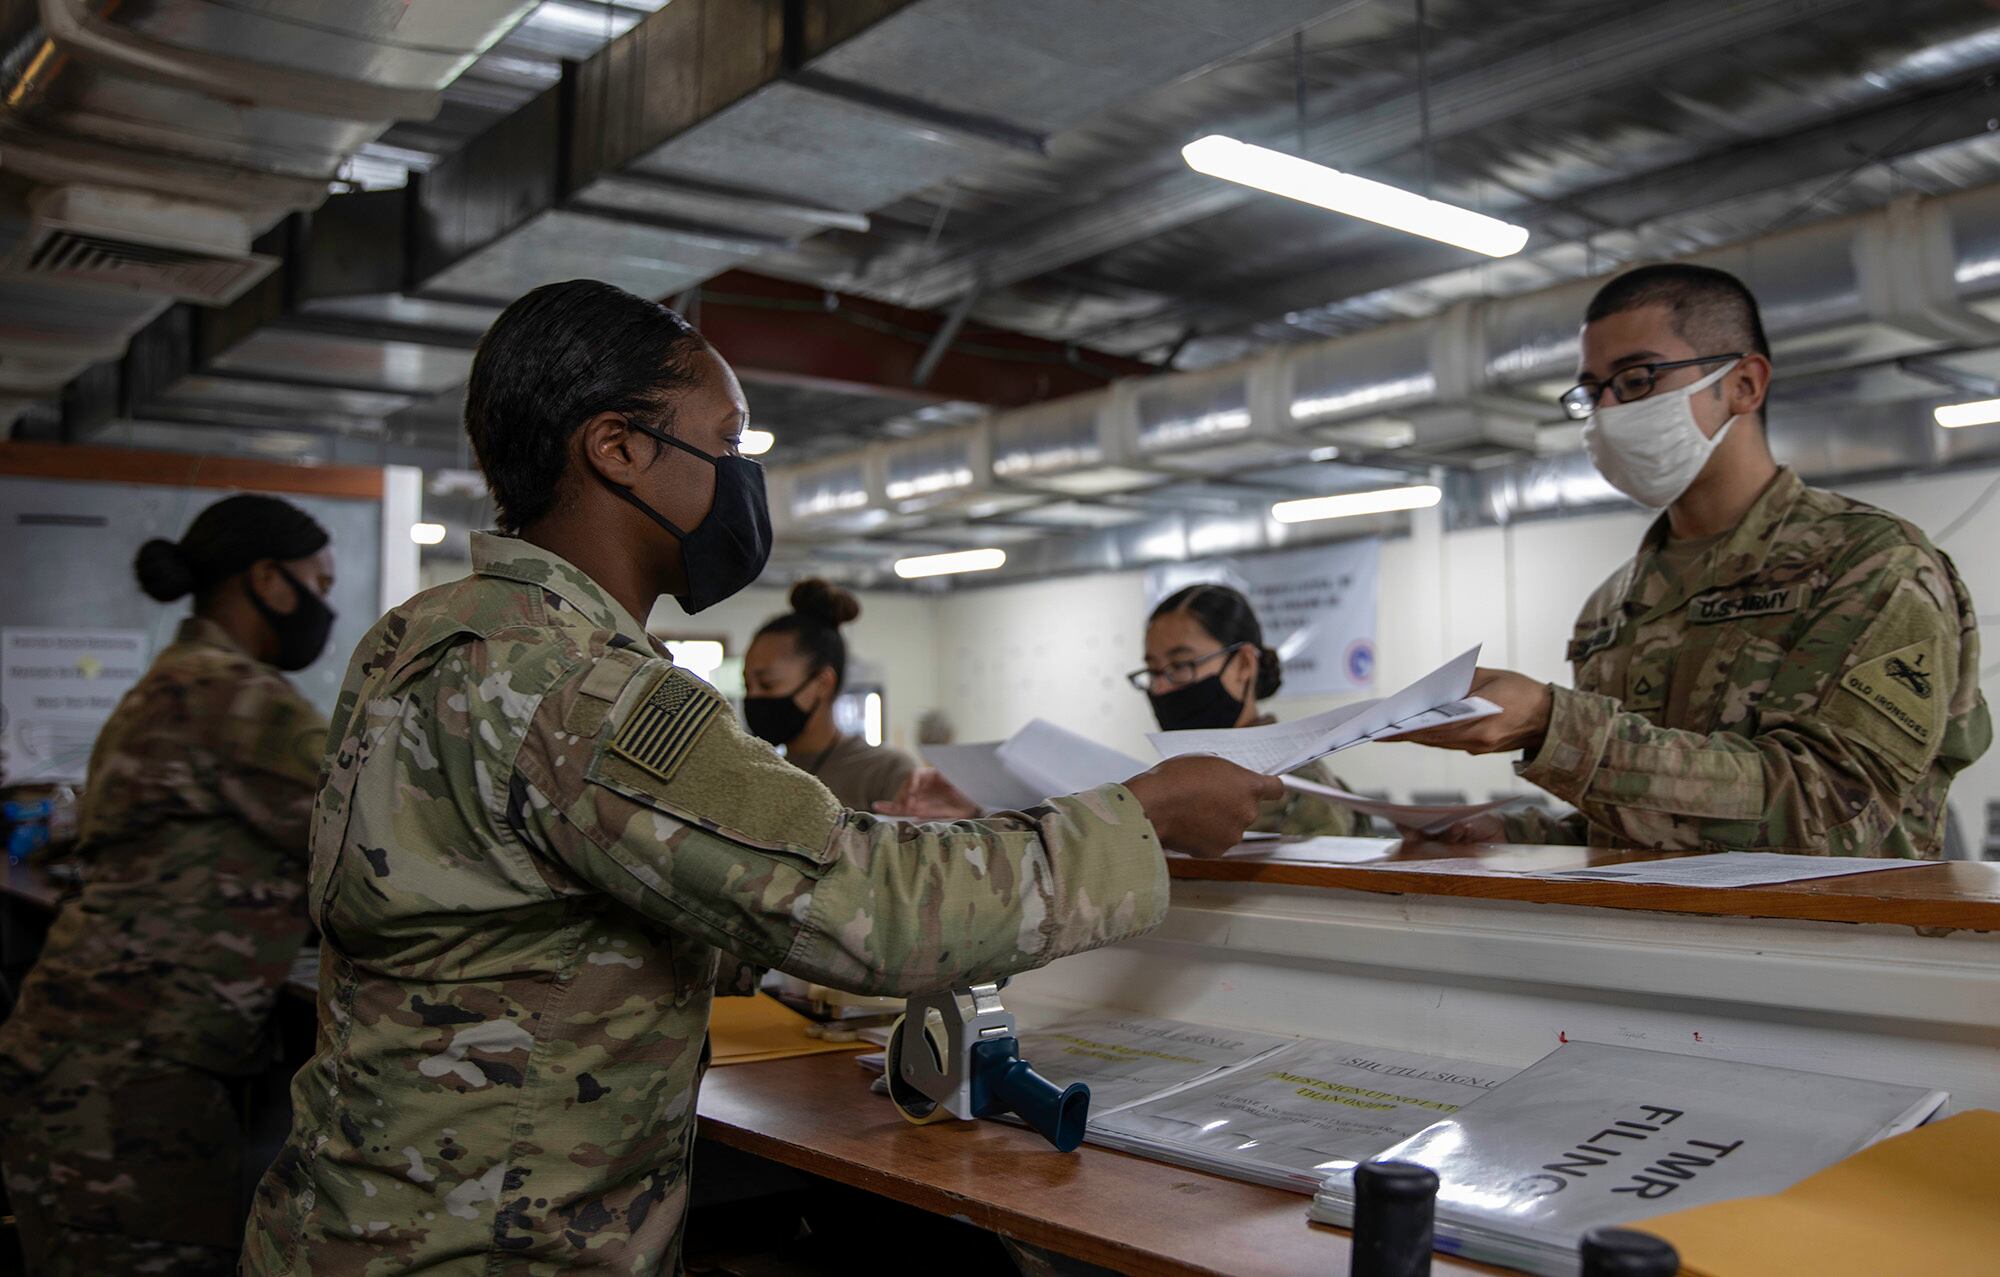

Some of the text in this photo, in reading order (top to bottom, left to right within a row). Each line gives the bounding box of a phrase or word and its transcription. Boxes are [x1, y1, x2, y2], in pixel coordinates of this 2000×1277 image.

[1738, 591, 1790, 611] ARMY
[1915, 653, 1925, 667] 1
[1849, 678, 1929, 738] OLD IRONSIDES
[1437, 1072, 1486, 1086] SIGN
[1511, 1105, 1685, 1198] FILING
[1611, 1140, 1744, 1199] TMR
